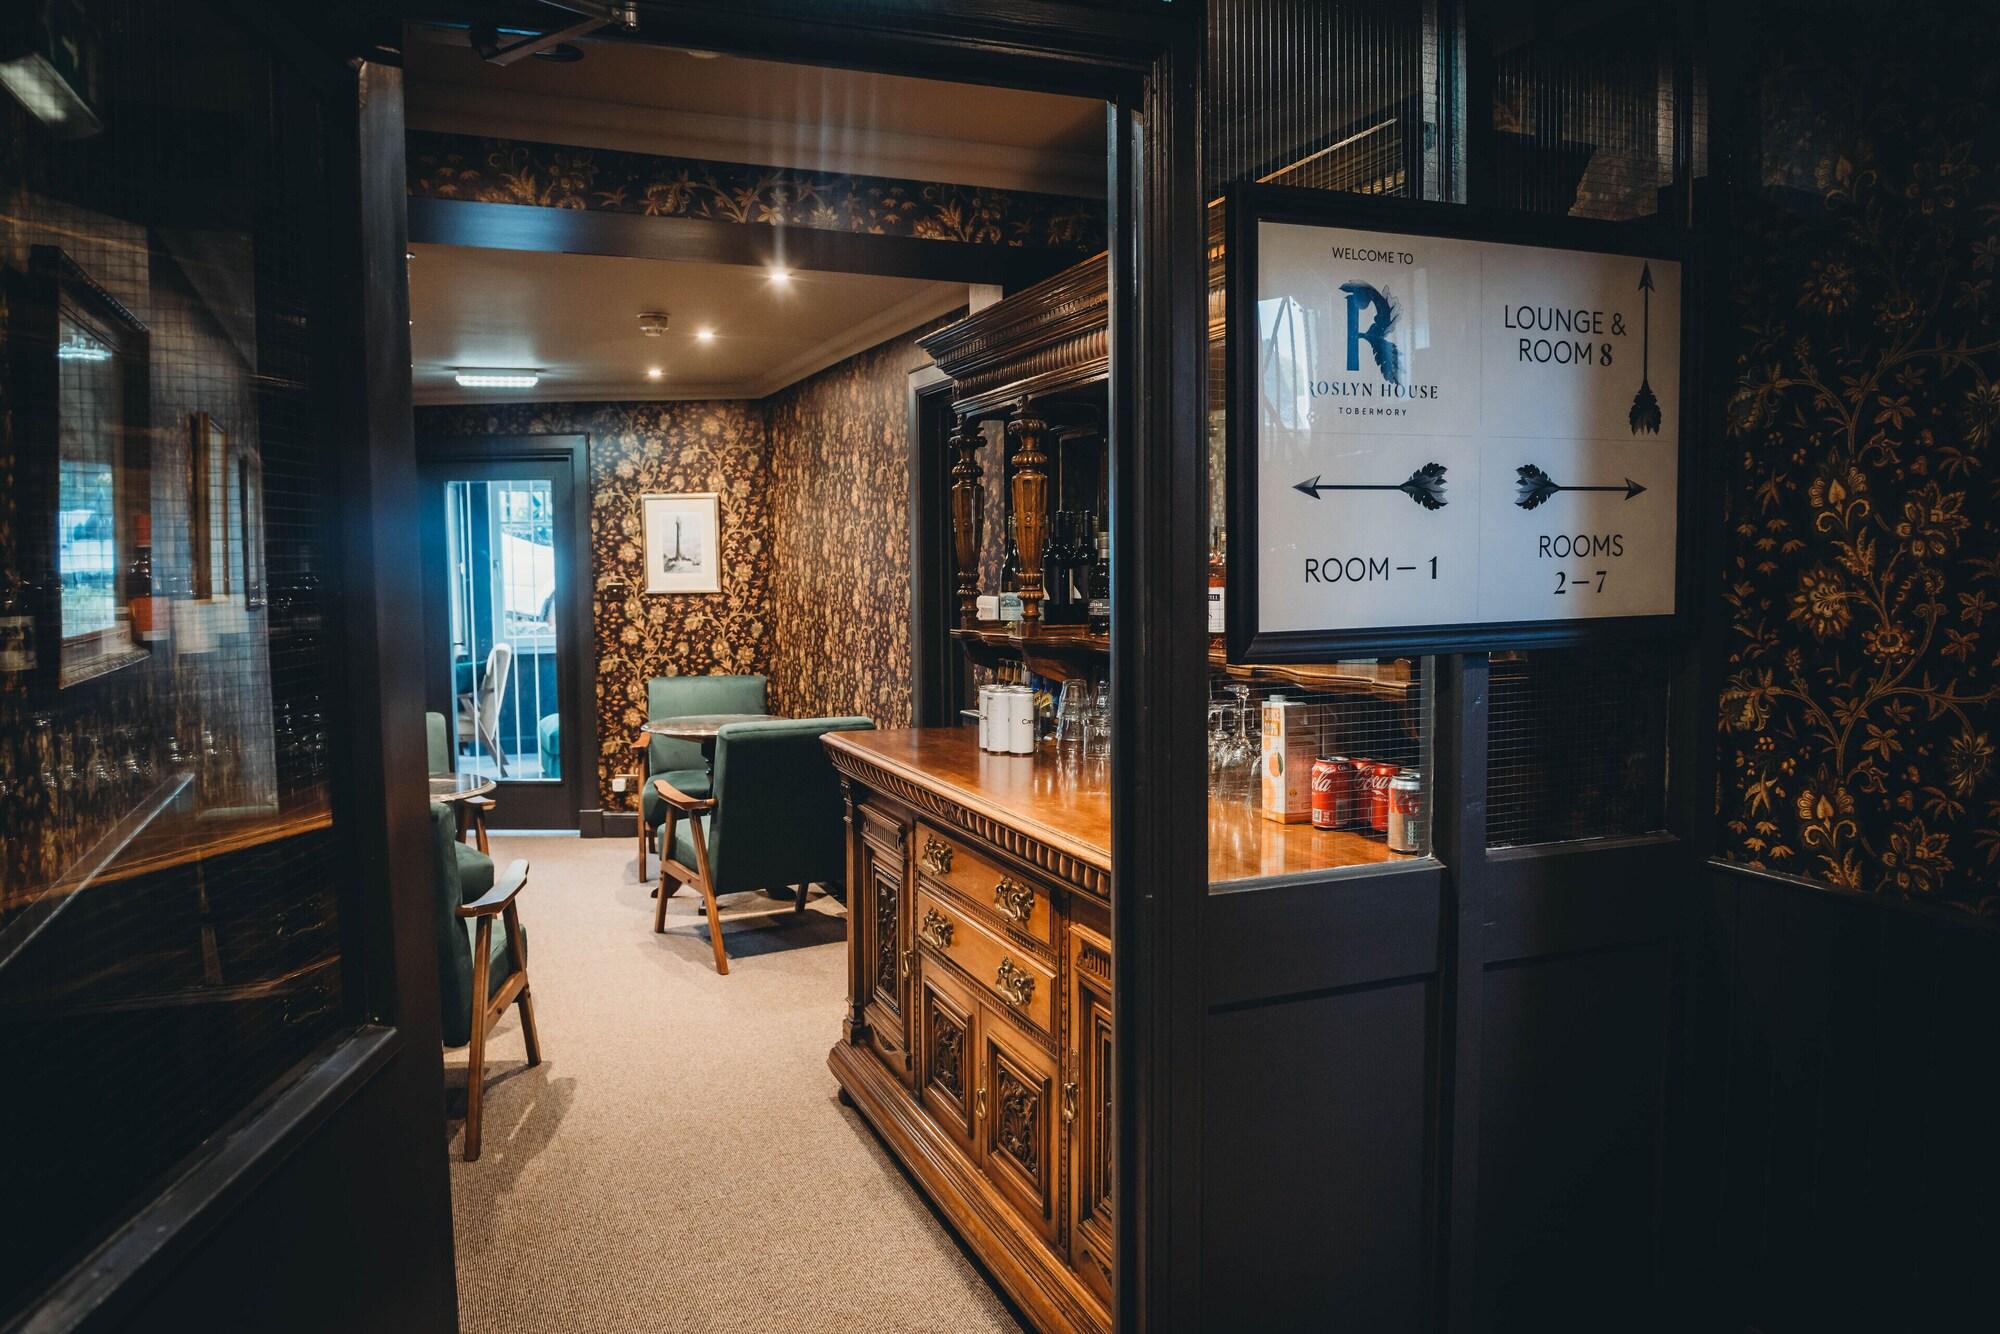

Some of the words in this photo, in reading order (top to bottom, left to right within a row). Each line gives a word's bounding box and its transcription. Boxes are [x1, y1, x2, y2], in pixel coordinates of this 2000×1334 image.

[1332, 247, 1394, 263] WELCOME
[1398, 252, 1414, 265] TO
[1504, 304, 1604, 335] LOUNGE
[1611, 312, 1627, 336] &
[1519, 338, 1593, 366] ROOM
[1599, 342, 1613, 367] 8
[1381, 382, 1439, 399] HOUSE
[1338, 406, 1408, 416] TOBERMORY
[1538, 534, 1624, 558] ROOMS
[1304, 556, 1390, 583] ROOM
